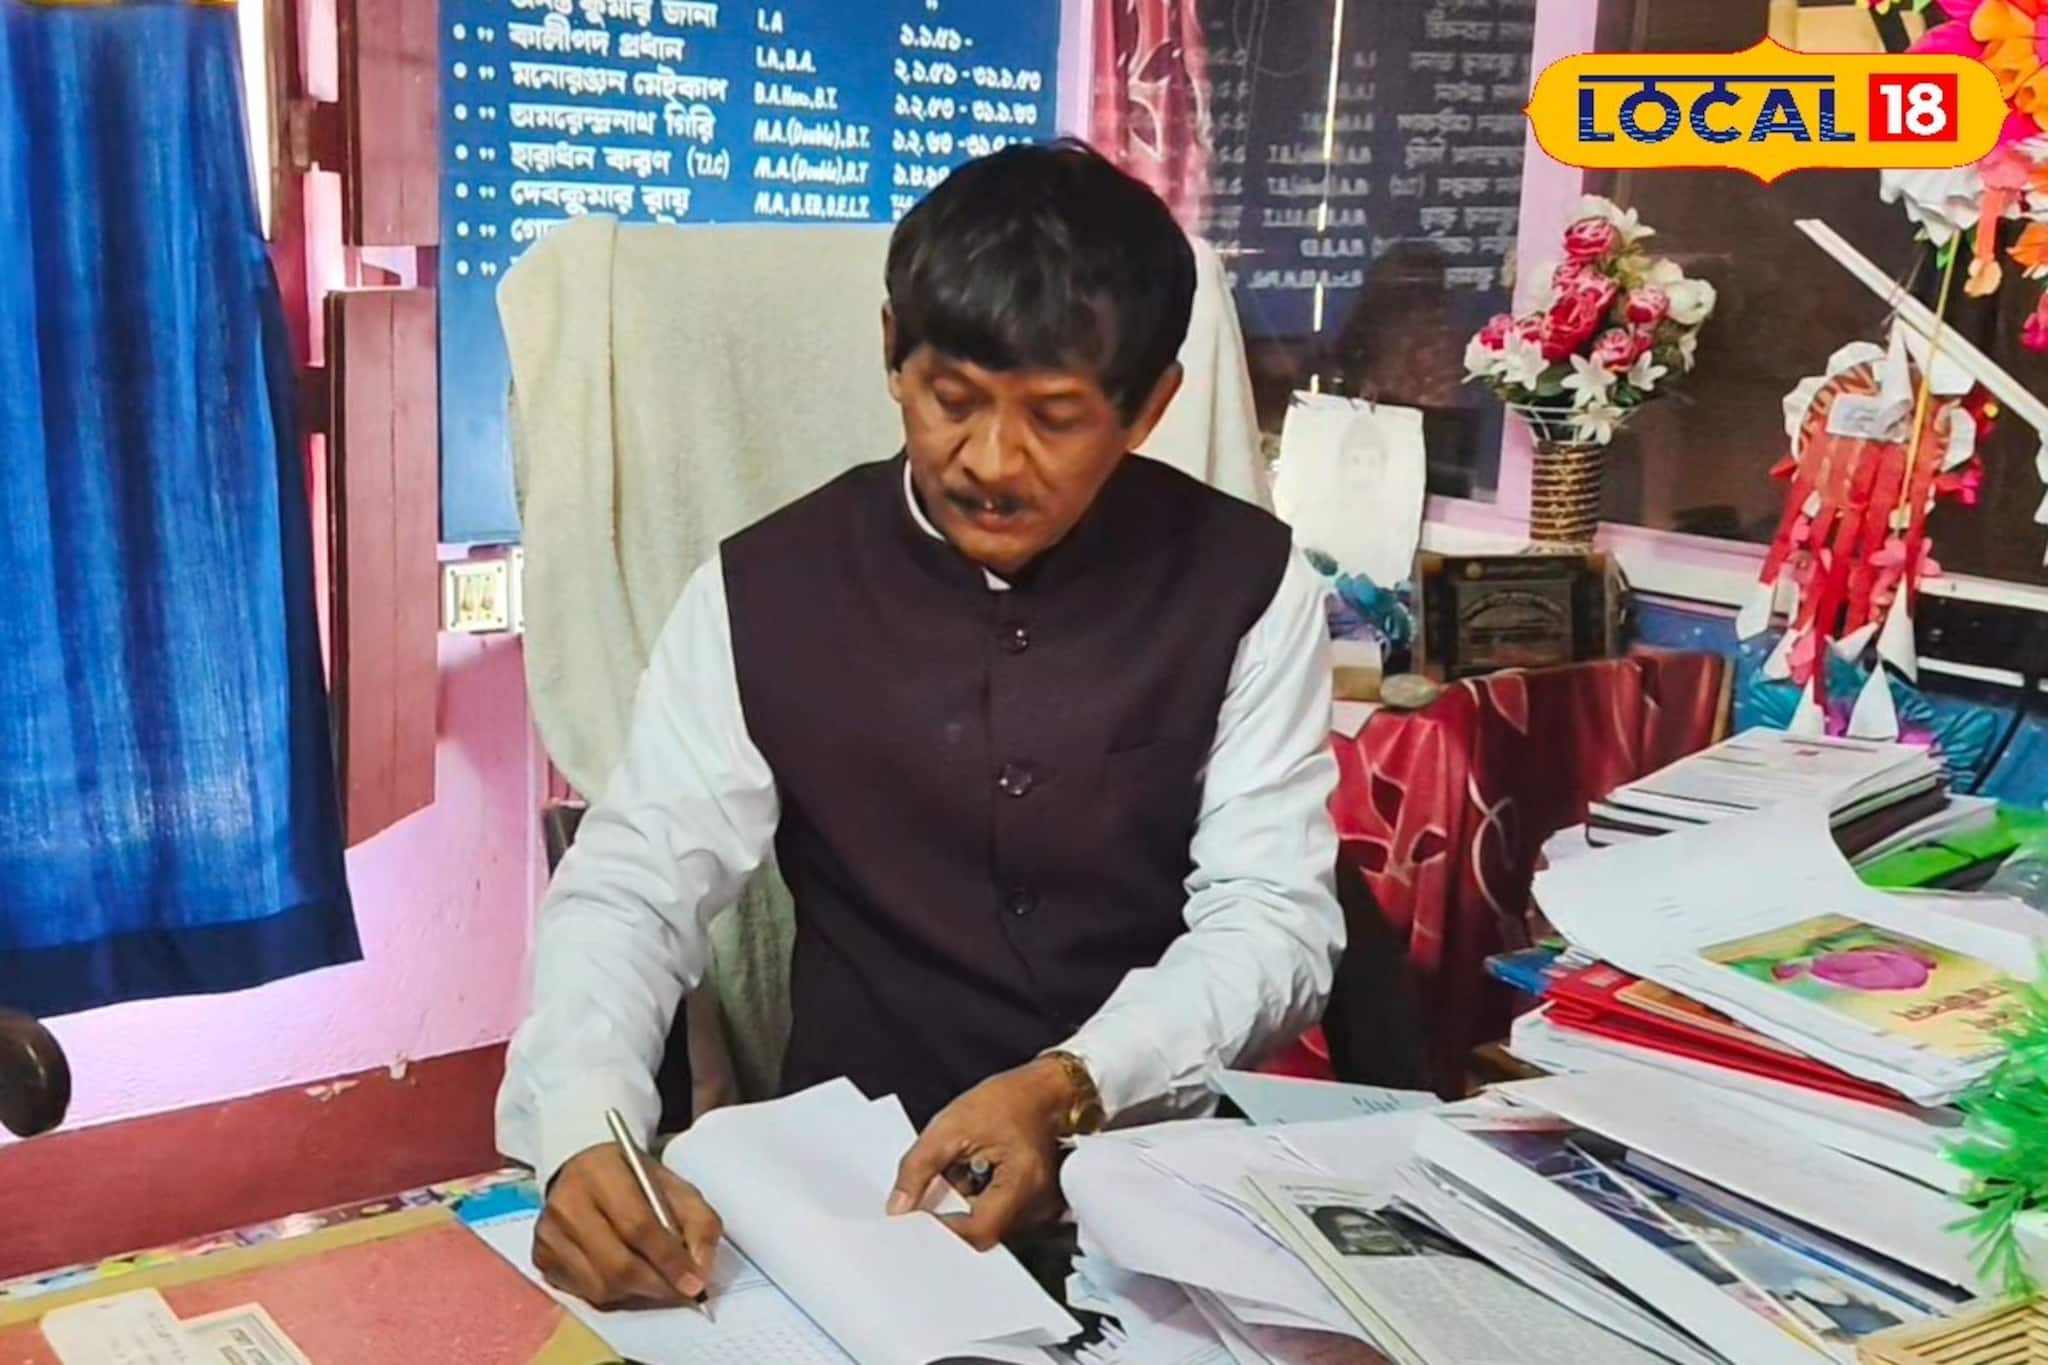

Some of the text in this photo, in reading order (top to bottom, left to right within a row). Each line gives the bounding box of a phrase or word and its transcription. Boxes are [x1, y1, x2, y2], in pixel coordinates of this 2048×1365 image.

[579, 0, 652, 28] কুমার
[661, 0, 718, 28] জানা
[508, 12, 685, 61] কালীপদ প্রধান
[663, 101, 716, 144] গিরি
[509, 141, 596, 173] হারাধন
[602, 146, 672, 178] করণ
[510, 180, 691, 217] দেবকুমার রায়
